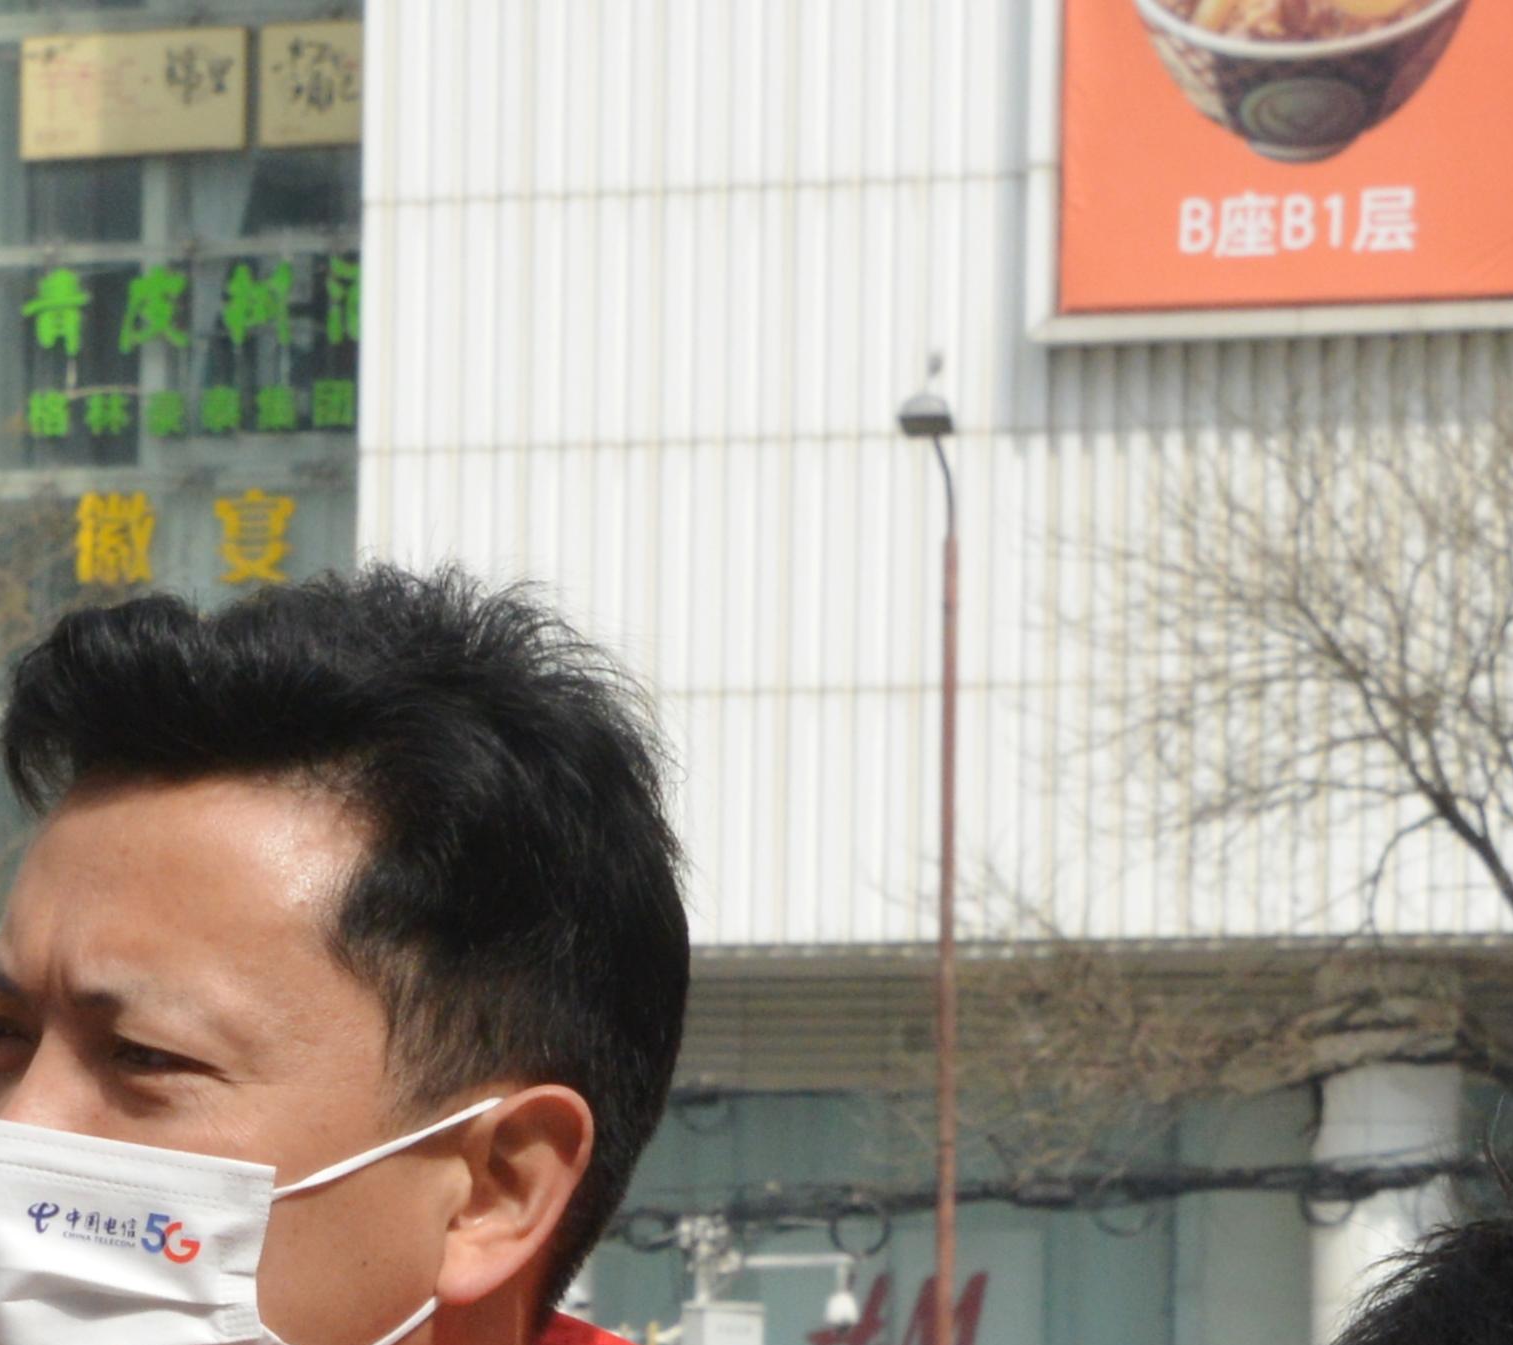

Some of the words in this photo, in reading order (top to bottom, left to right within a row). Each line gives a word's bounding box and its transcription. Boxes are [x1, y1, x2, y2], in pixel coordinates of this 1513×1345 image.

[1178, 186, 1417, 258] B座B1层
[63, 1231, 91, 1242] CHINA
[94, 1236, 136, 1248] TELECOM
[66, 1208, 139, 1238] 中国电信
[141, 1213, 201, 1264] 5G
